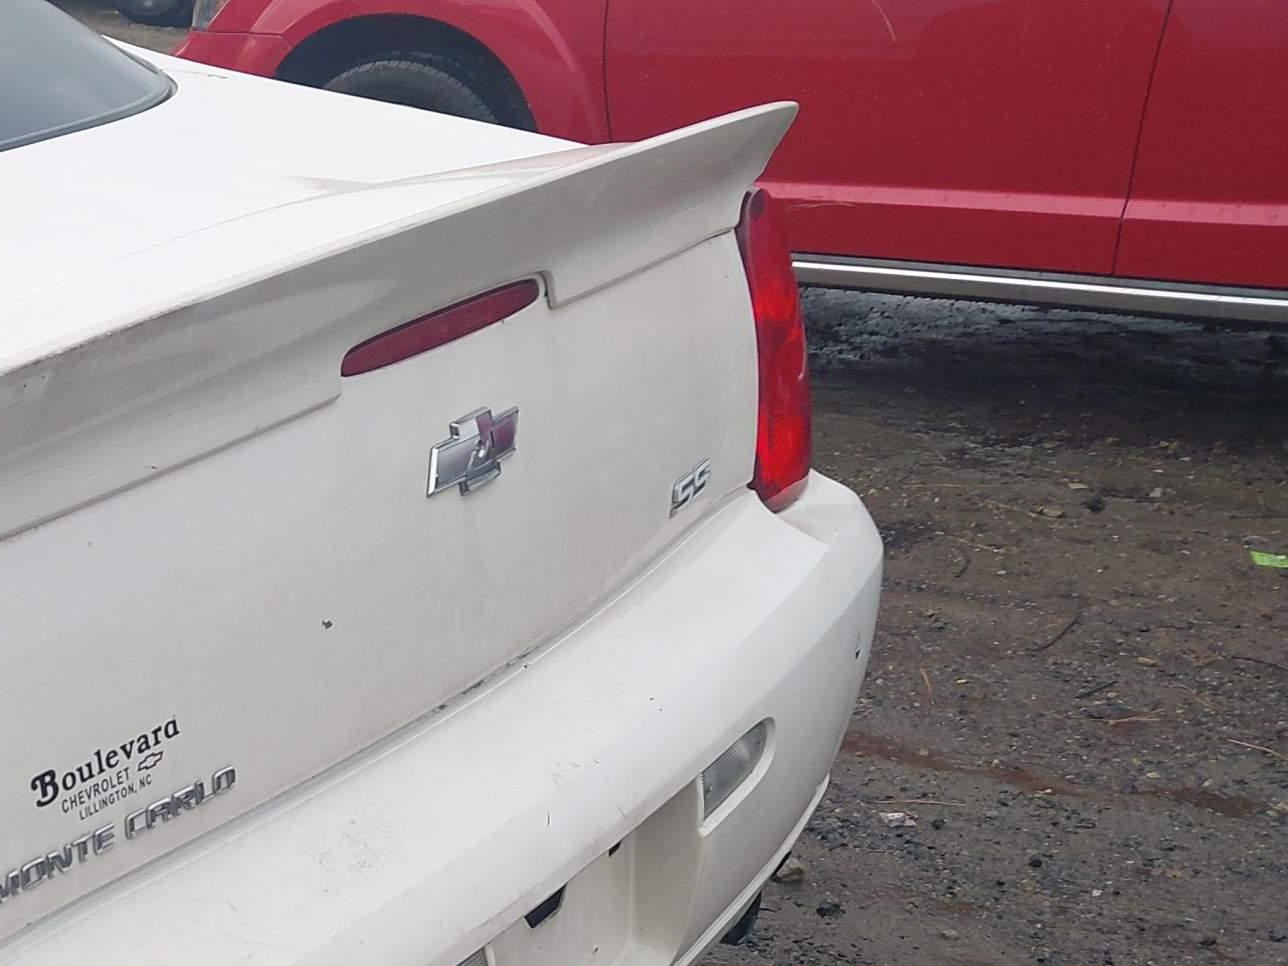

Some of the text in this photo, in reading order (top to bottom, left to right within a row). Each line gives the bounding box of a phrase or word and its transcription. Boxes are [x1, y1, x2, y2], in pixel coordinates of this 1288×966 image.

[669, 456, 712, 518] SS
[30, 716, 181, 808] Boulevard
[61, 767, 130, 814] CHEVROLET
[79, 774, 152, 821] LILLINGTON, NC
[124, 765, 236, 840] CARLO
